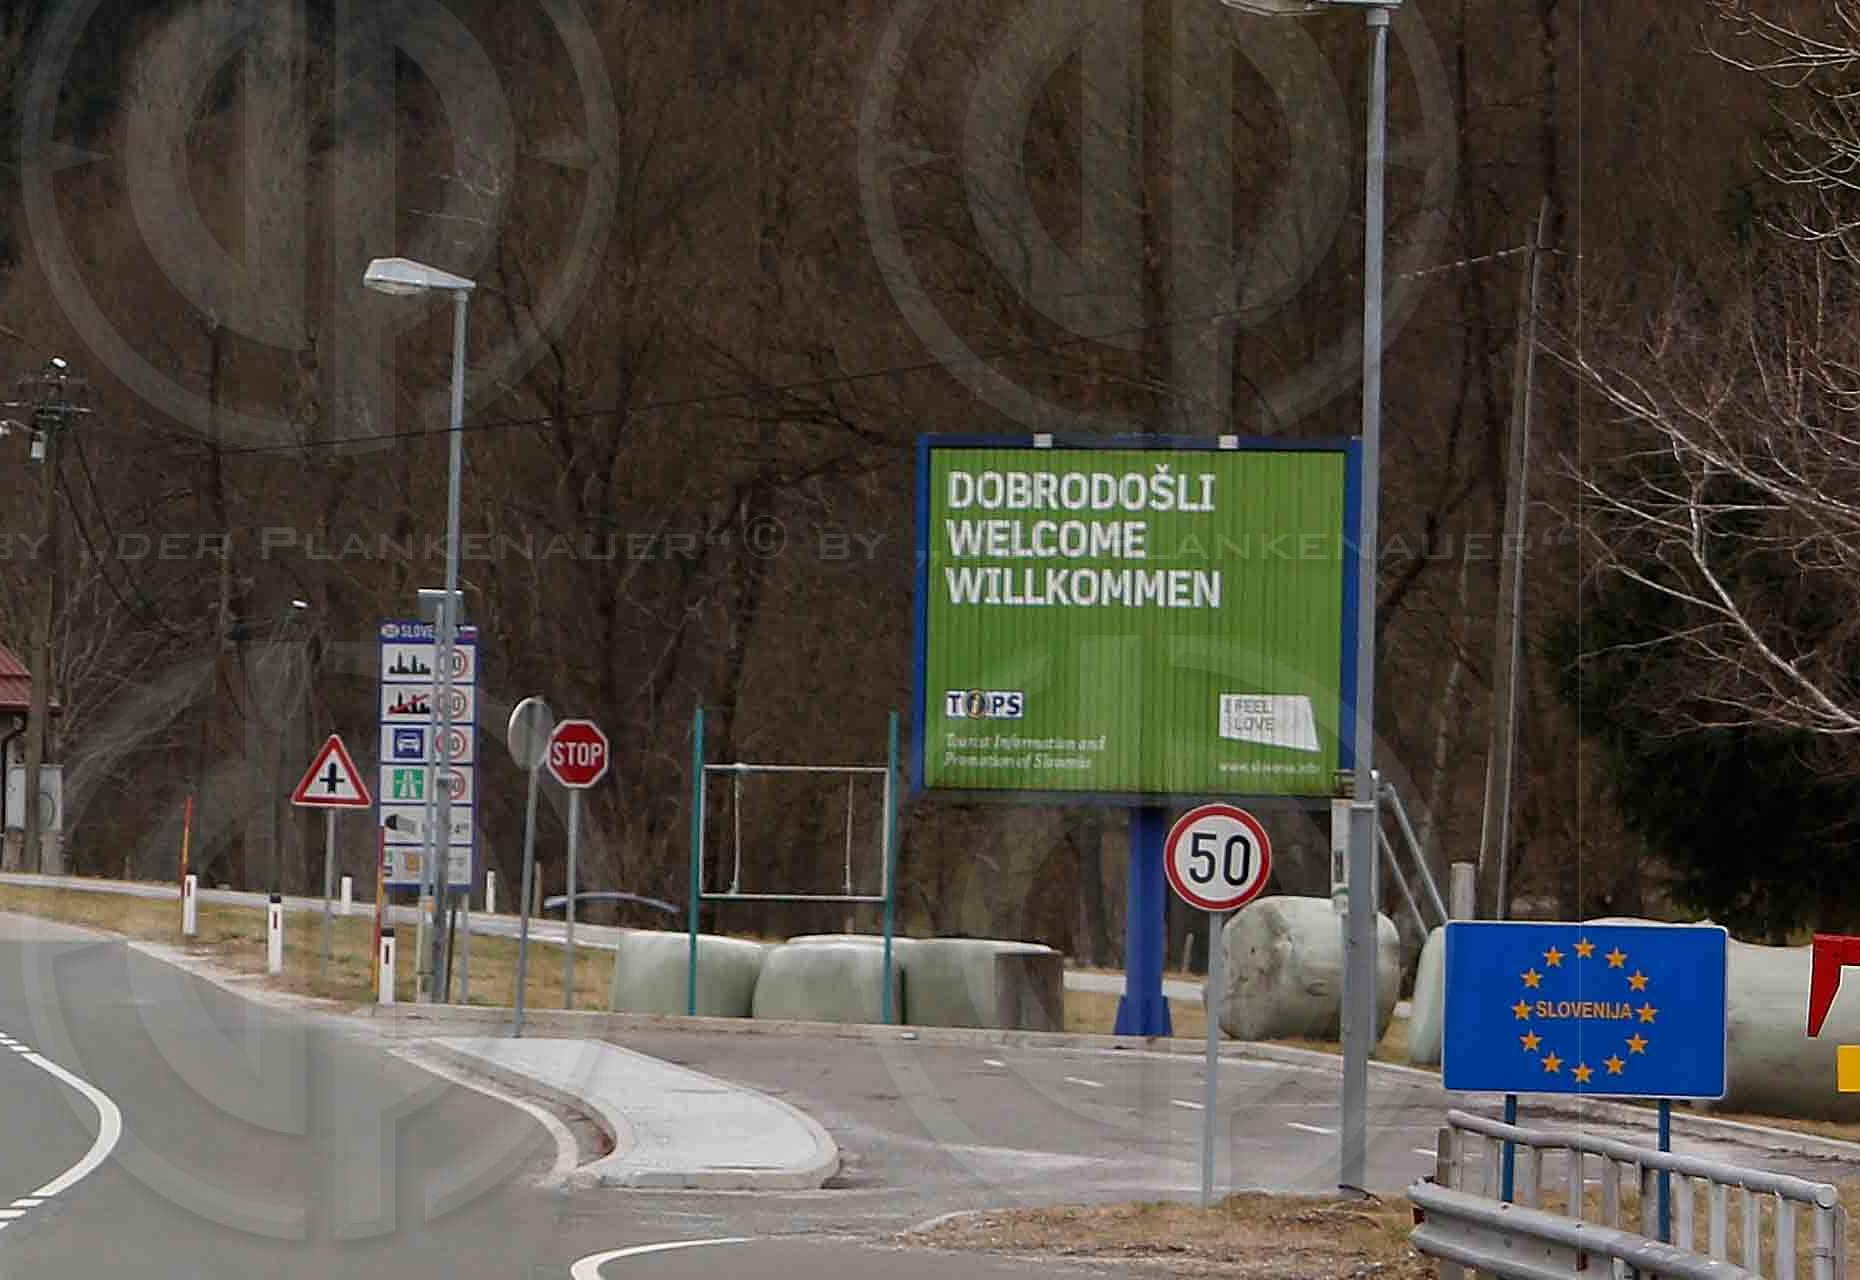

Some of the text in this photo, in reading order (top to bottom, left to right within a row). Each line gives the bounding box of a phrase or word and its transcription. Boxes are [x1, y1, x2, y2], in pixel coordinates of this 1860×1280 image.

[947, 465, 1216, 511] DOBRODOŠLI
[947, 520, 1147, 559] WELCOME
[946, 568, 1222, 608] WILLKOMMEN
[552, 741, 603, 767] STOP
[1188, 832, 1253, 887] 50
[1535, 1000, 1633, 1021] SLOVENIJA
